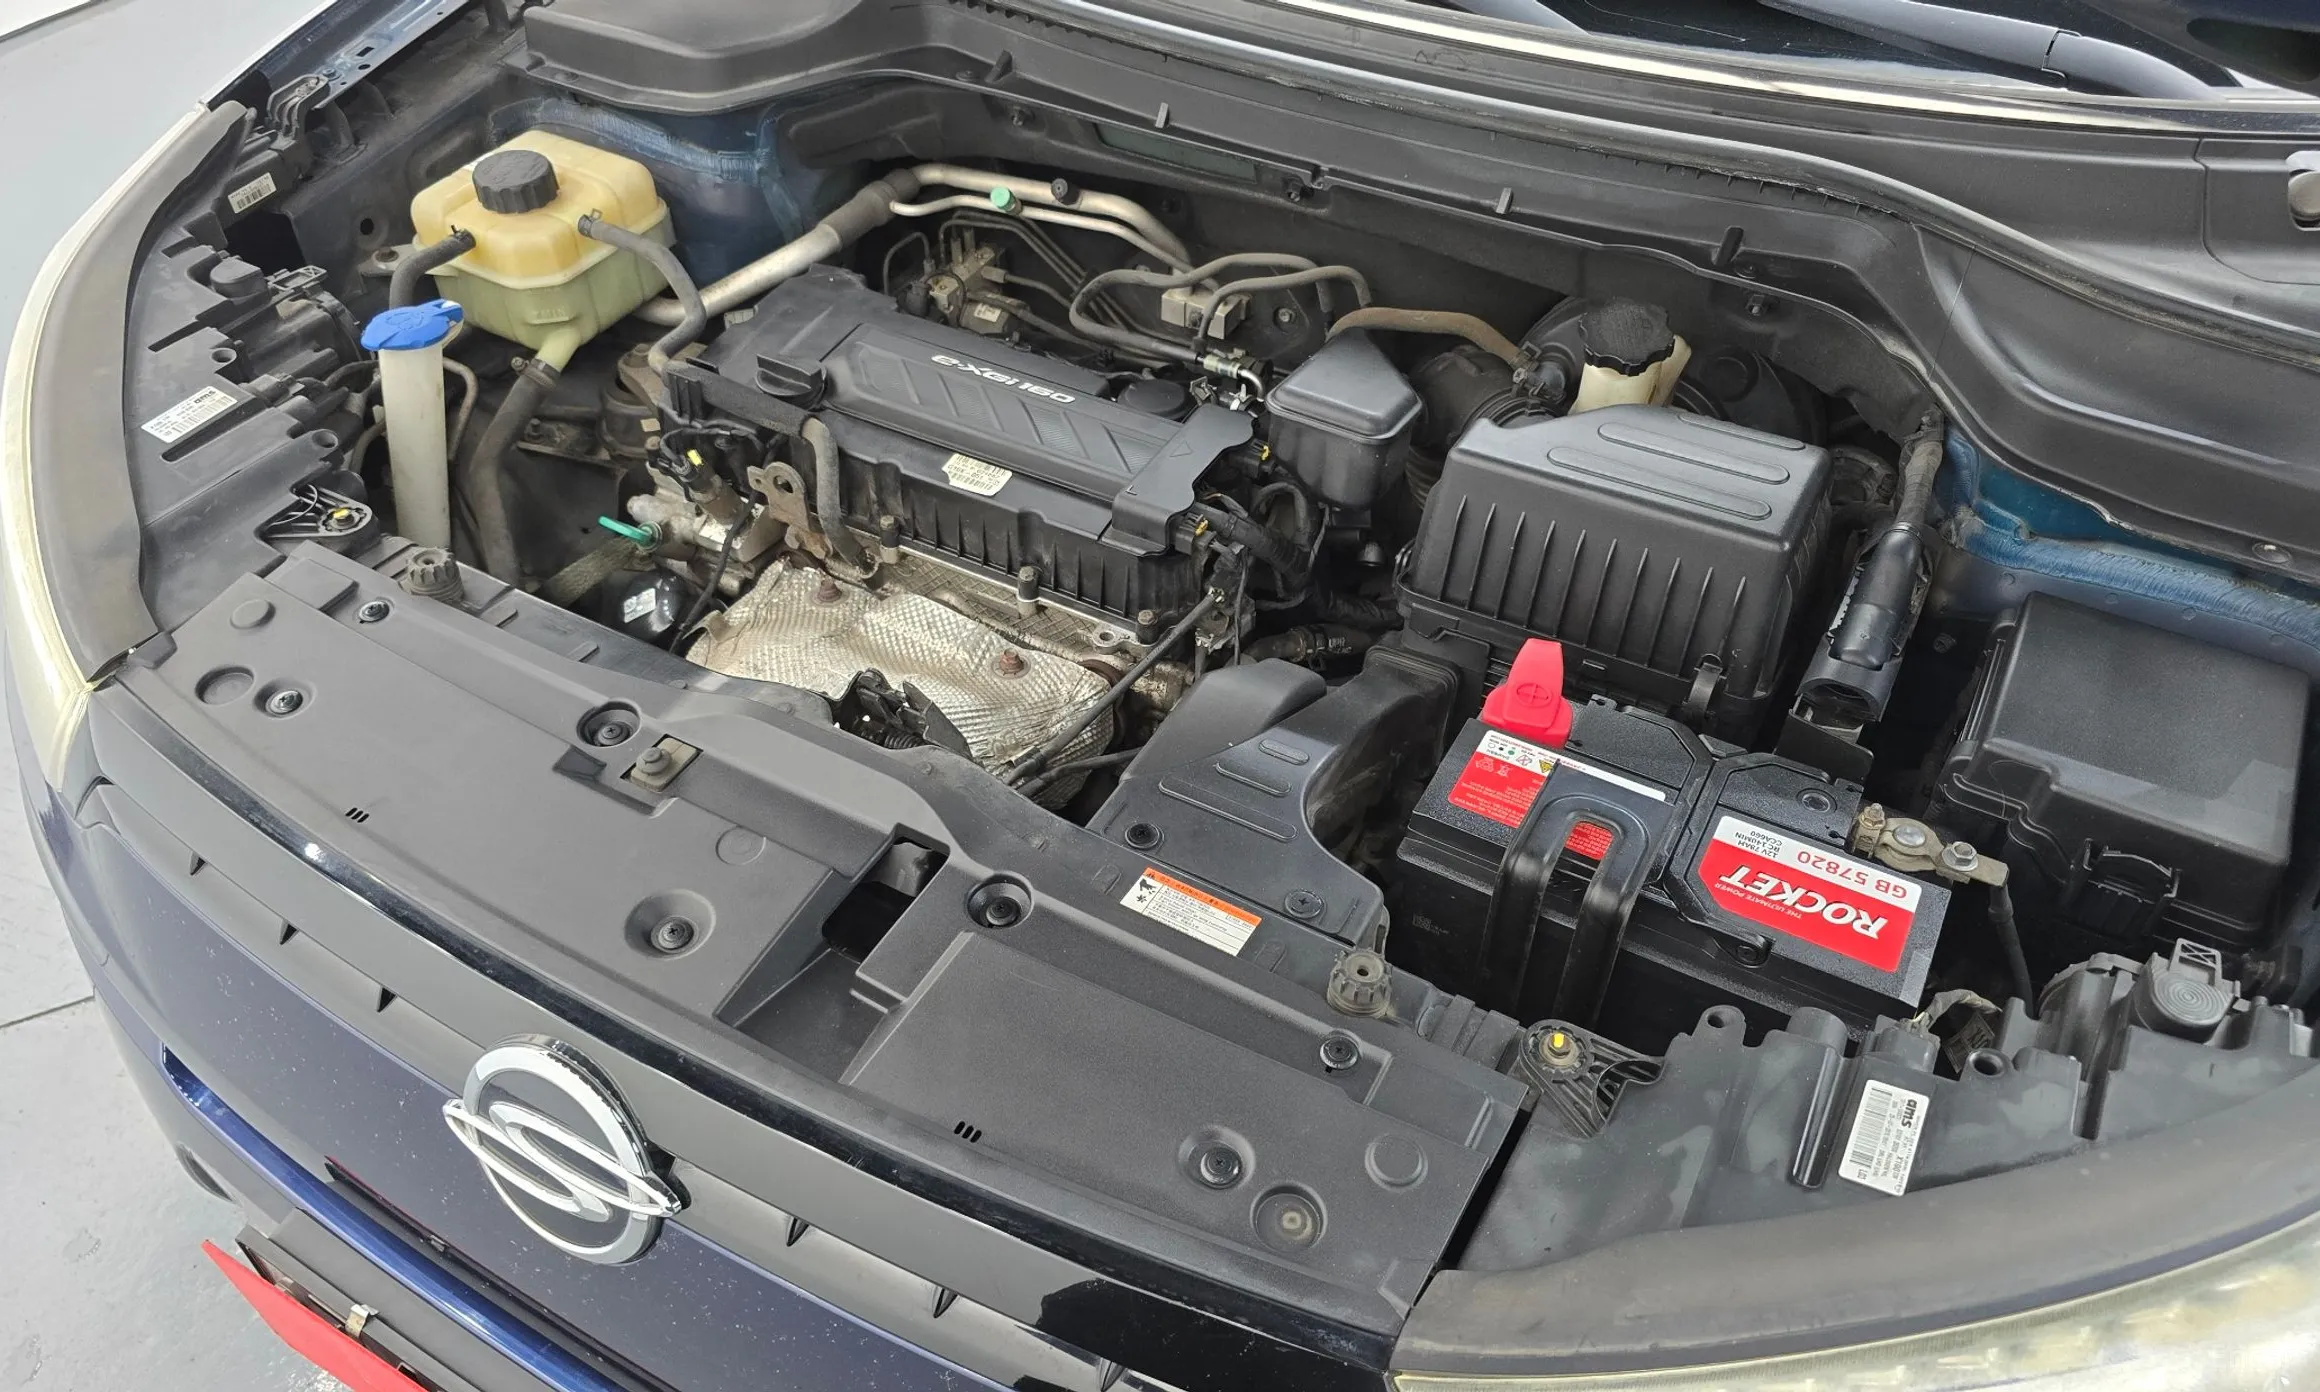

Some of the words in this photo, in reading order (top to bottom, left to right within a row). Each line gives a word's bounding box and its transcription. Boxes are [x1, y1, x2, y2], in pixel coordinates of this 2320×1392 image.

[1018, 382, 1076, 403] 160
[1762, 848, 1779, 859] 12V
[1797, 850, 1870, 886] 57820
[1714, 882, 1748, 900] POWER
[1875, 879, 1907, 899] GB
[1719, 864, 1888, 940] ROCKET
[1749, 895, 1785, 914] ULTIMATE
[1785, 908, 1802, 920] THE
[1901, 1098, 1918, 1129] ams
